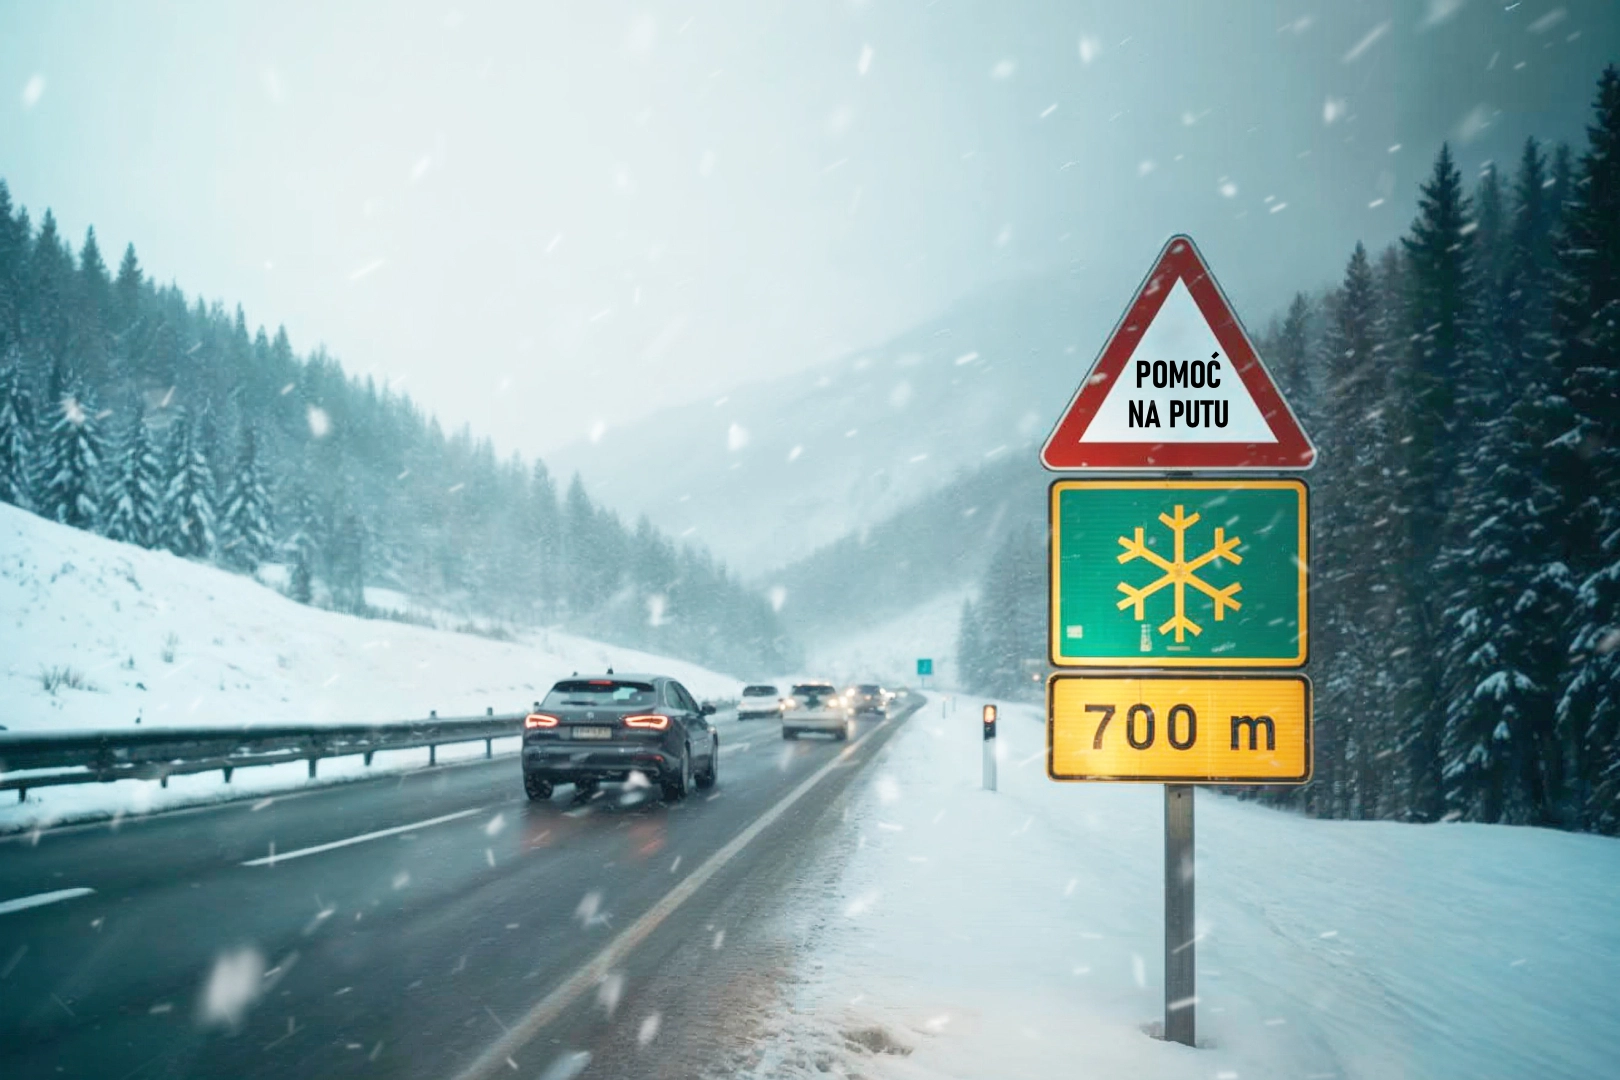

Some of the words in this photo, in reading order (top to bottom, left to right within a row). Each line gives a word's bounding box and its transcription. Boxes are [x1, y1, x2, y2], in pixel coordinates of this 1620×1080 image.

[1136, 351, 1221, 388] POMOĆ
[1128, 400, 1161, 428] NA
[1169, 400, 1229, 428] PUTU
[1084, 703, 1197, 751] 700
[1230, 715, 1276, 751] m
